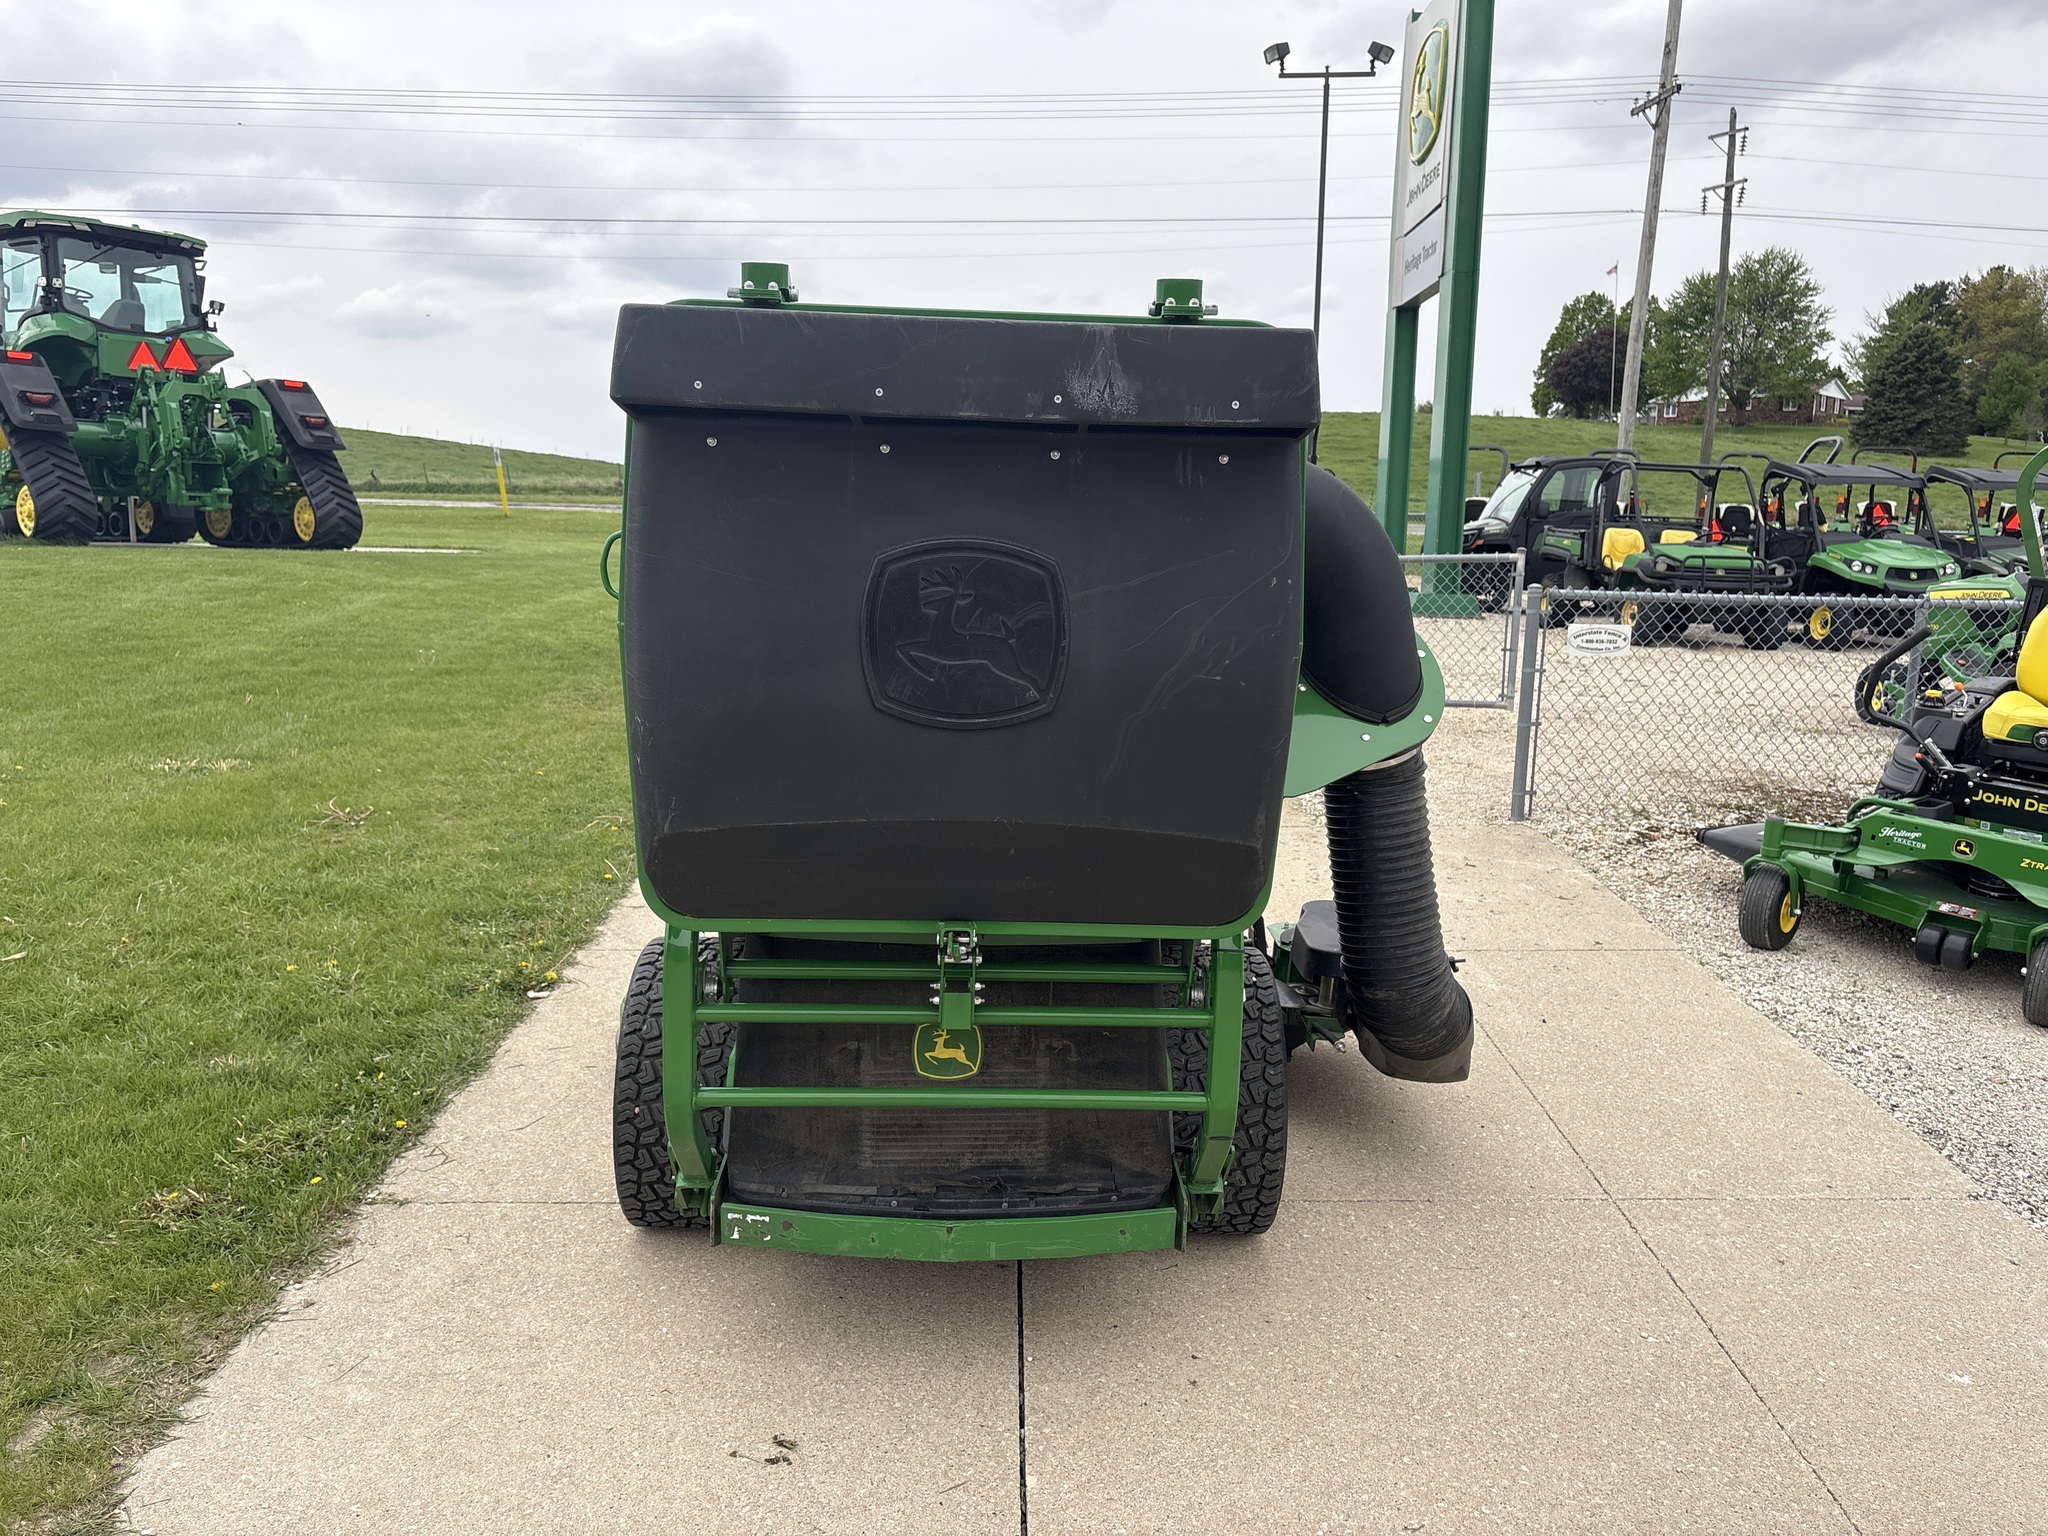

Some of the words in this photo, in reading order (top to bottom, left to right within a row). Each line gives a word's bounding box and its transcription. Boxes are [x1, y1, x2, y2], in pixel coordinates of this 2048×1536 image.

[1406, 180, 1421, 208] JOHN
[1421, 161, 1441, 194] DEERE
[1404, 251, 1422, 276] Heritage
[1422, 240, 1438, 263] Tractor
[1960, 592, 1977, 600] JOHN
[1978, 591, 2003, 599] DEERE
[1573, 630, 1603, 640] Interstate
[1604, 630, 1622, 638] Fence
[1972, 789, 2020, 809] JOHN
[1878, 826, 1922, 840] Heritage
[1893, 836, 1927, 850] TRACTOR
